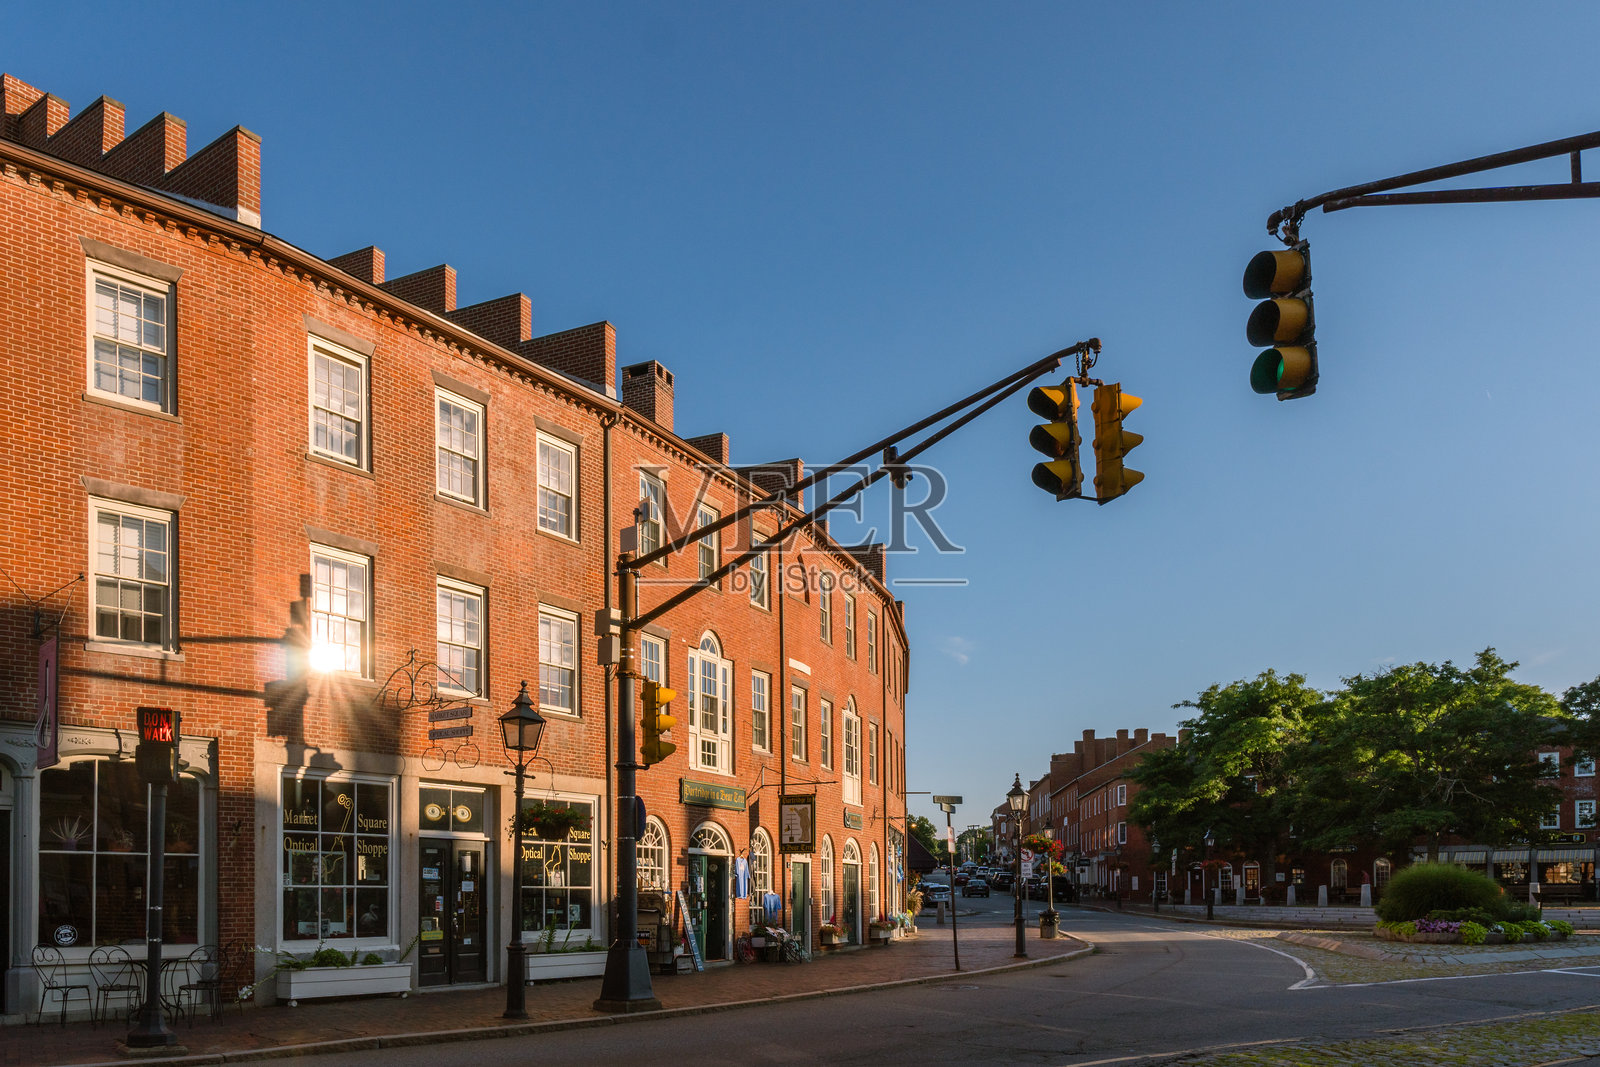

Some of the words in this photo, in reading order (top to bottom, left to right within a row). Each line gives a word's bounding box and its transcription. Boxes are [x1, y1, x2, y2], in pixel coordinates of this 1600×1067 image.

[144, 727, 172, 742] WALK
[684, 784, 710, 801] Partridge
[710, 789, 716, 799] in
[716, 791, 720, 800] a
[720, 789, 733, 802] Bear
[284, 809, 318, 825] Market
[358, 813, 388, 832] Square
[569, 826, 591, 842] Square
[284, 837, 318, 855] Optical
[357, 839, 388, 858] Shoppe
[569, 848, 591, 864] Shoppe
